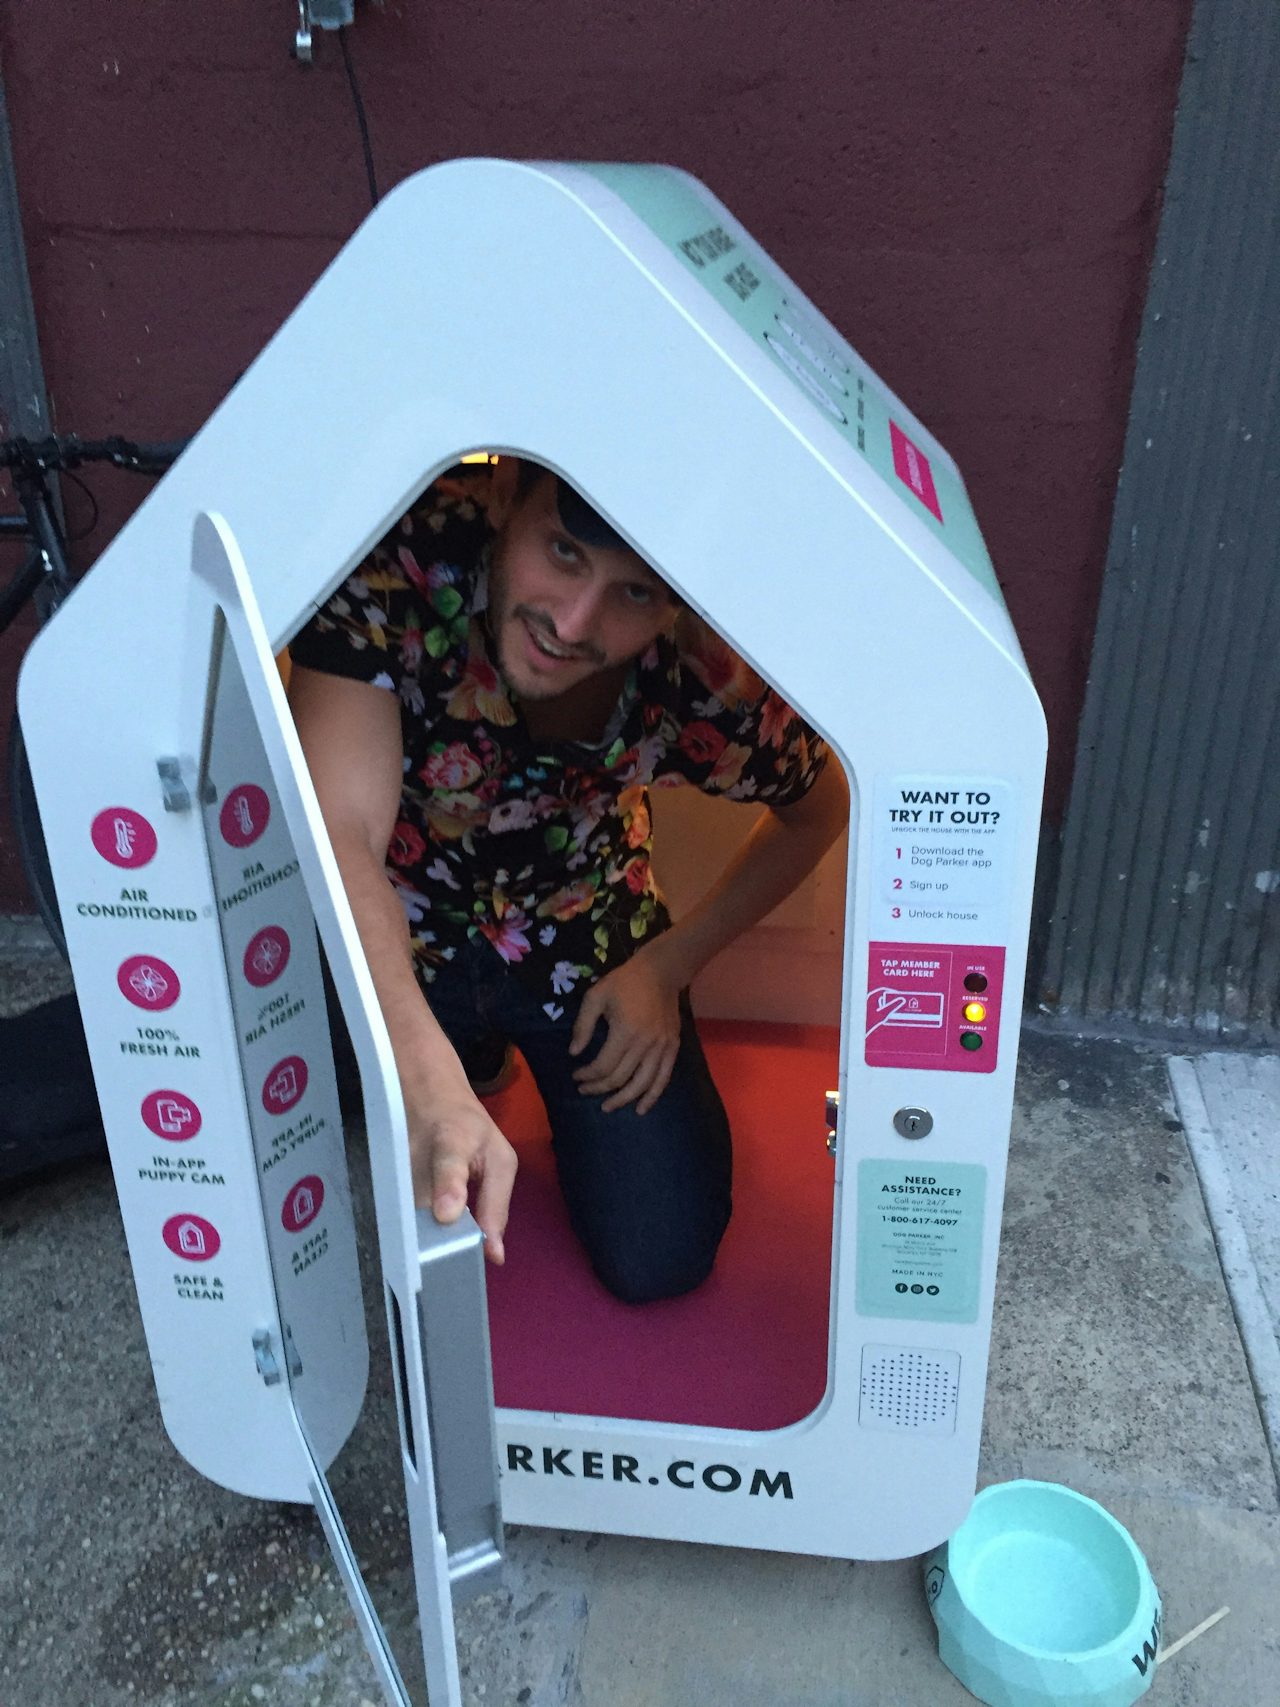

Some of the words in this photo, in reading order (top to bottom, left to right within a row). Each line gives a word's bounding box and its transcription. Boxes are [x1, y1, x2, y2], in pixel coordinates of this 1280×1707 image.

[901, 791, 959, 804] WANT
[966, 793, 990, 805] TO
[889, 810, 922, 822] TRY
[929, 811, 944, 823] IT
[950, 811, 1000, 824] OUT?
[896, 848, 902, 859] 1
[911, 846, 964, 856] Download
[967, 847, 984, 856] the
[911, 857, 933, 867] Dog
[936, 858, 969, 866] Parker
[972, 860, 992, 868] app
[893, 879, 902, 889] 2
[910, 881, 932, 890] Sign
[120, 888, 149, 902] AIR
[77, 903, 198, 922] CONDITIONED
[892, 907, 901, 918] 3
[908, 910, 944, 919] Unlock
[947, 911, 978, 920] house
[881, 959, 898, 967] TAP
[901, 960, 940, 969] MEMBER
[884, 969, 909, 977] CARD
[137, 1027, 180, 1041] 100%
[120, 1042, 168, 1057] FRESH
[174, 1045, 200, 1058] AIR
[153, 1156, 206, 1169] IN-APP
[138, 1169, 185, 1183] PUPPY
[191, 1172, 226, 1185] CAM
[905, 1176, 936, 1185] NEED
[881, 1185, 961, 1196] ASSISTANCE?
[882, 1215, 958, 1226] 1-800-617-4097
[174, 1274, 207, 1287] SAFE
[213, 1277, 224, 1289] &
[178, 1289, 225, 1302] CLEAN
[498, 1444, 794, 1500] RKER.COM
